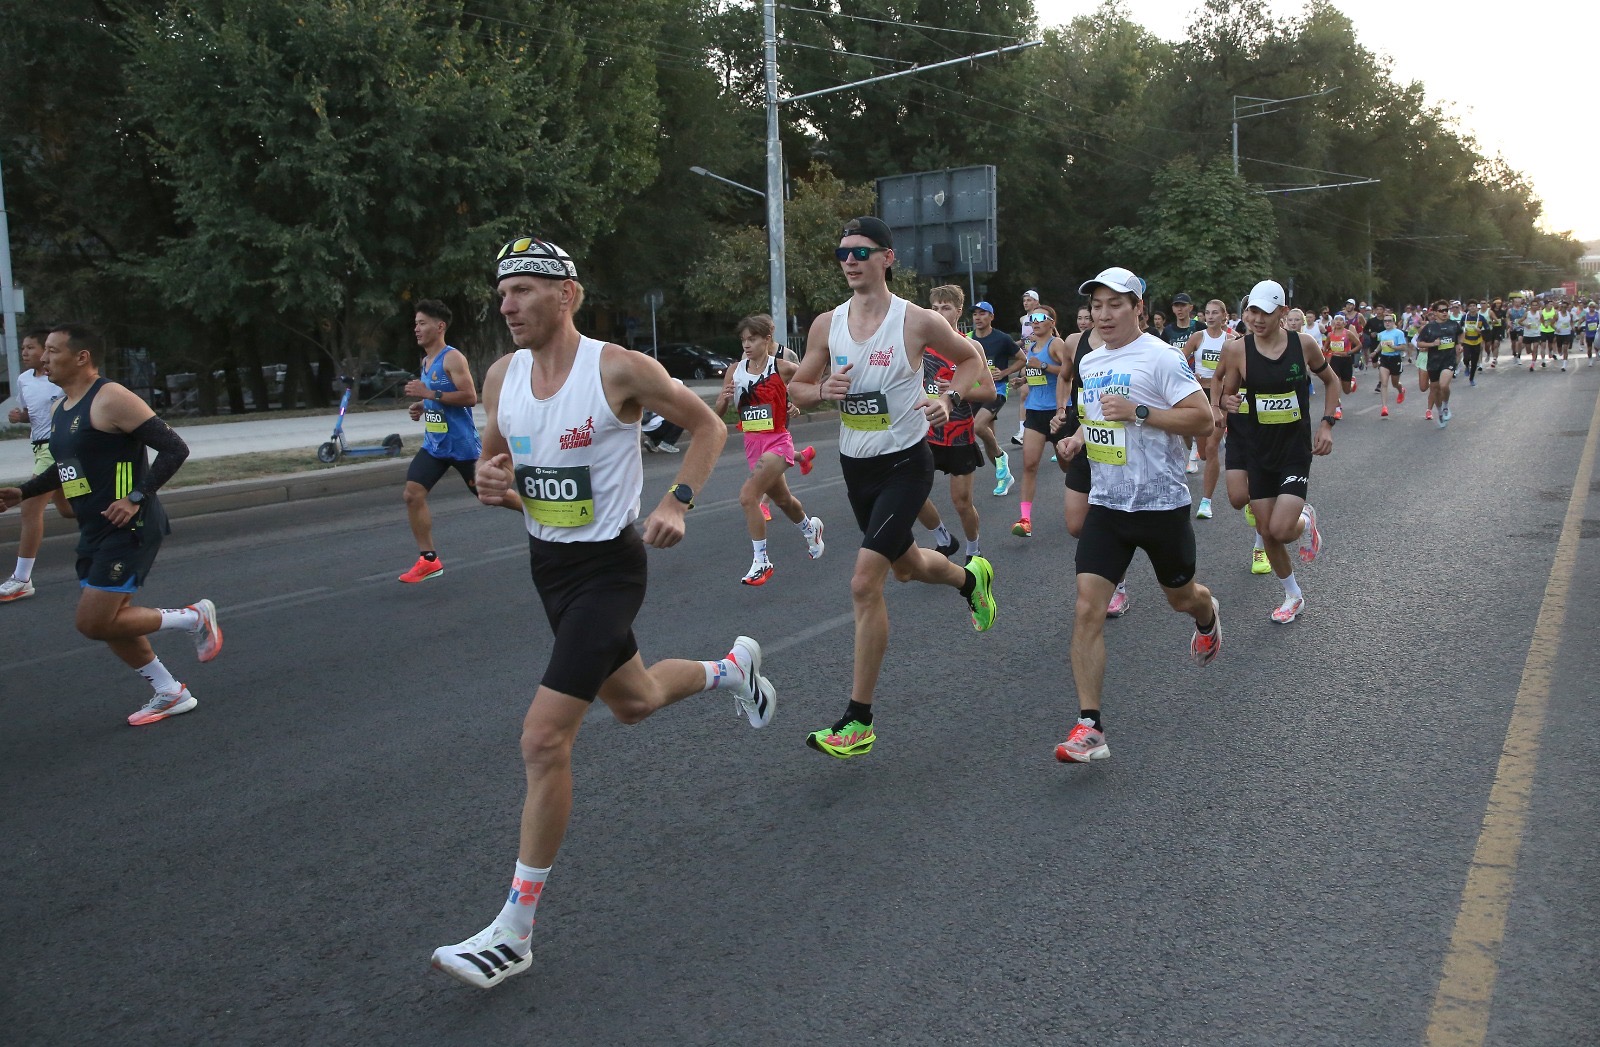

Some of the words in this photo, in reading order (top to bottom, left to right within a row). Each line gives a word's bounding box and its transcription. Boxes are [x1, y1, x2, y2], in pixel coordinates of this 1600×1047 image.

[1262, 398, 1292, 410] 7222
[744, 409, 768, 420] 12178
[560, 430, 590, 443] БЕГОВАЯ
[1086, 426, 1114, 445] 7081
[1116, 450, 1122, 458] C
[524, 476, 578, 500] 8100
[580, 506, 588, 516] A
